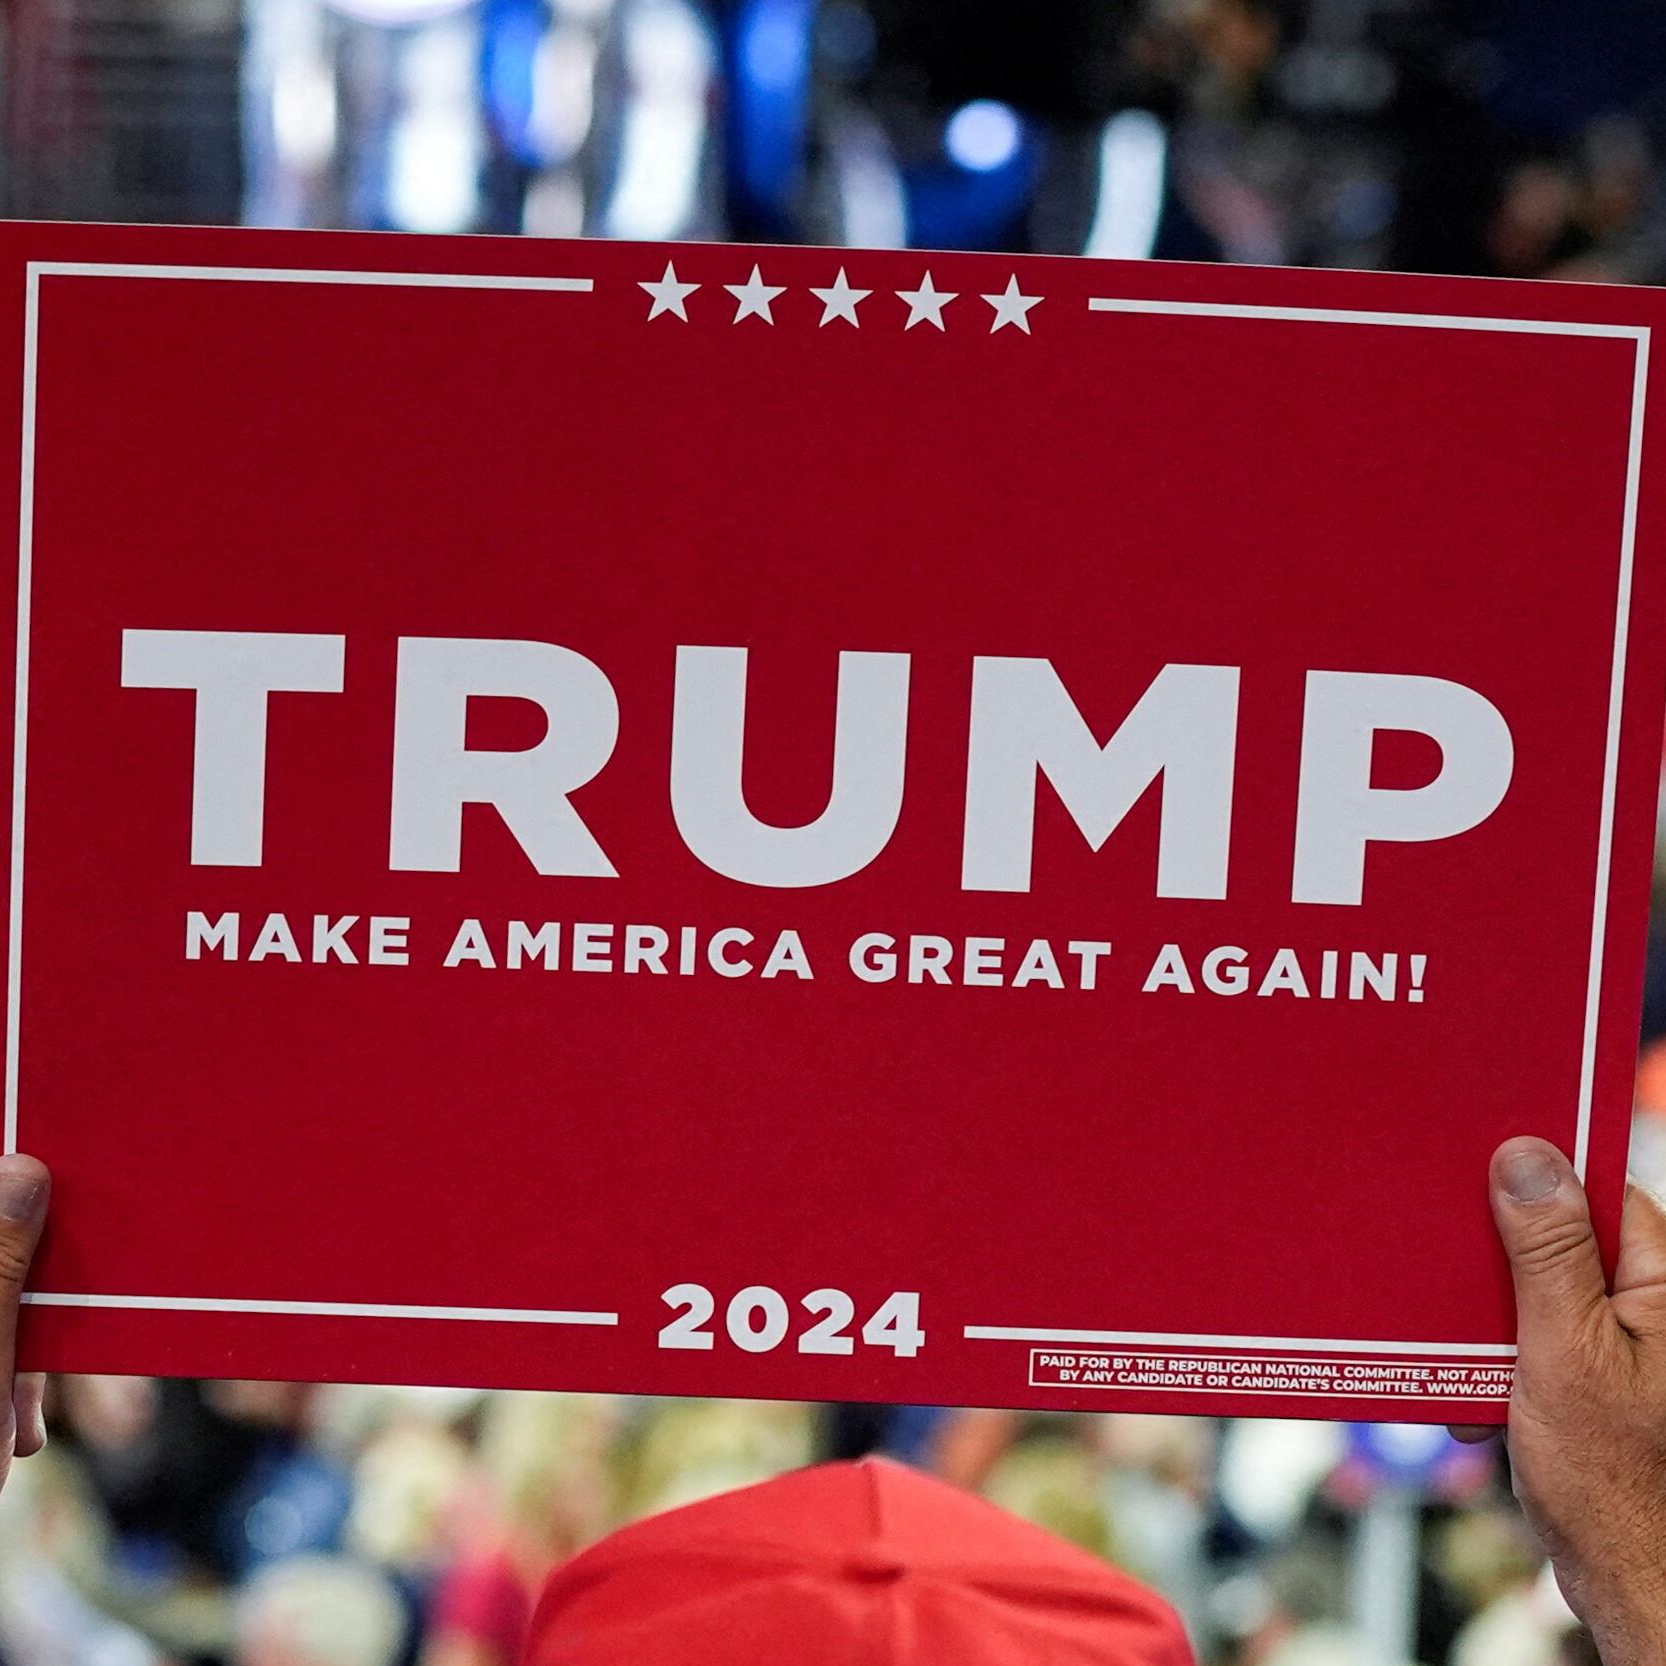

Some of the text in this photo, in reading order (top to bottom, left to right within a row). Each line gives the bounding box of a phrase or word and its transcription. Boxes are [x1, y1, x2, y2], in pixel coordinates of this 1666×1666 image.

[120, 628, 1515, 906] TRUMP
[185, 911, 1428, 1004] MAKE AMERICA GREAT AGAIN!
[658, 1283, 926, 1358] 2024
[1039, 1355, 1076, 1367] PAID
[1079, 1357, 1110, 1369] FOR
[1113, 1358, 1134, 1370] BY
[1135, 1359, 1165, 1371] THE
[1168, 1360, 1261, 1375] REPUBLICAN
[1265, 1363, 1341, 1378] NATIONAL
[1343, 1366, 1434, 1381] COMMITTEE.
[1437, 1369, 1469, 1381] NOT
[1059, 1370, 1080, 1381] BY
[1082, 1370, 1114, 1382] ANY
[1117, 1372, 1204, 1386] CANDIDATE
[1206, 1375, 1229, 1386] OR
[1231, 1375, 1330, 1391] CANDIDATE'S
[1332, 1379, 1423, 1394] COMMITTEE.
